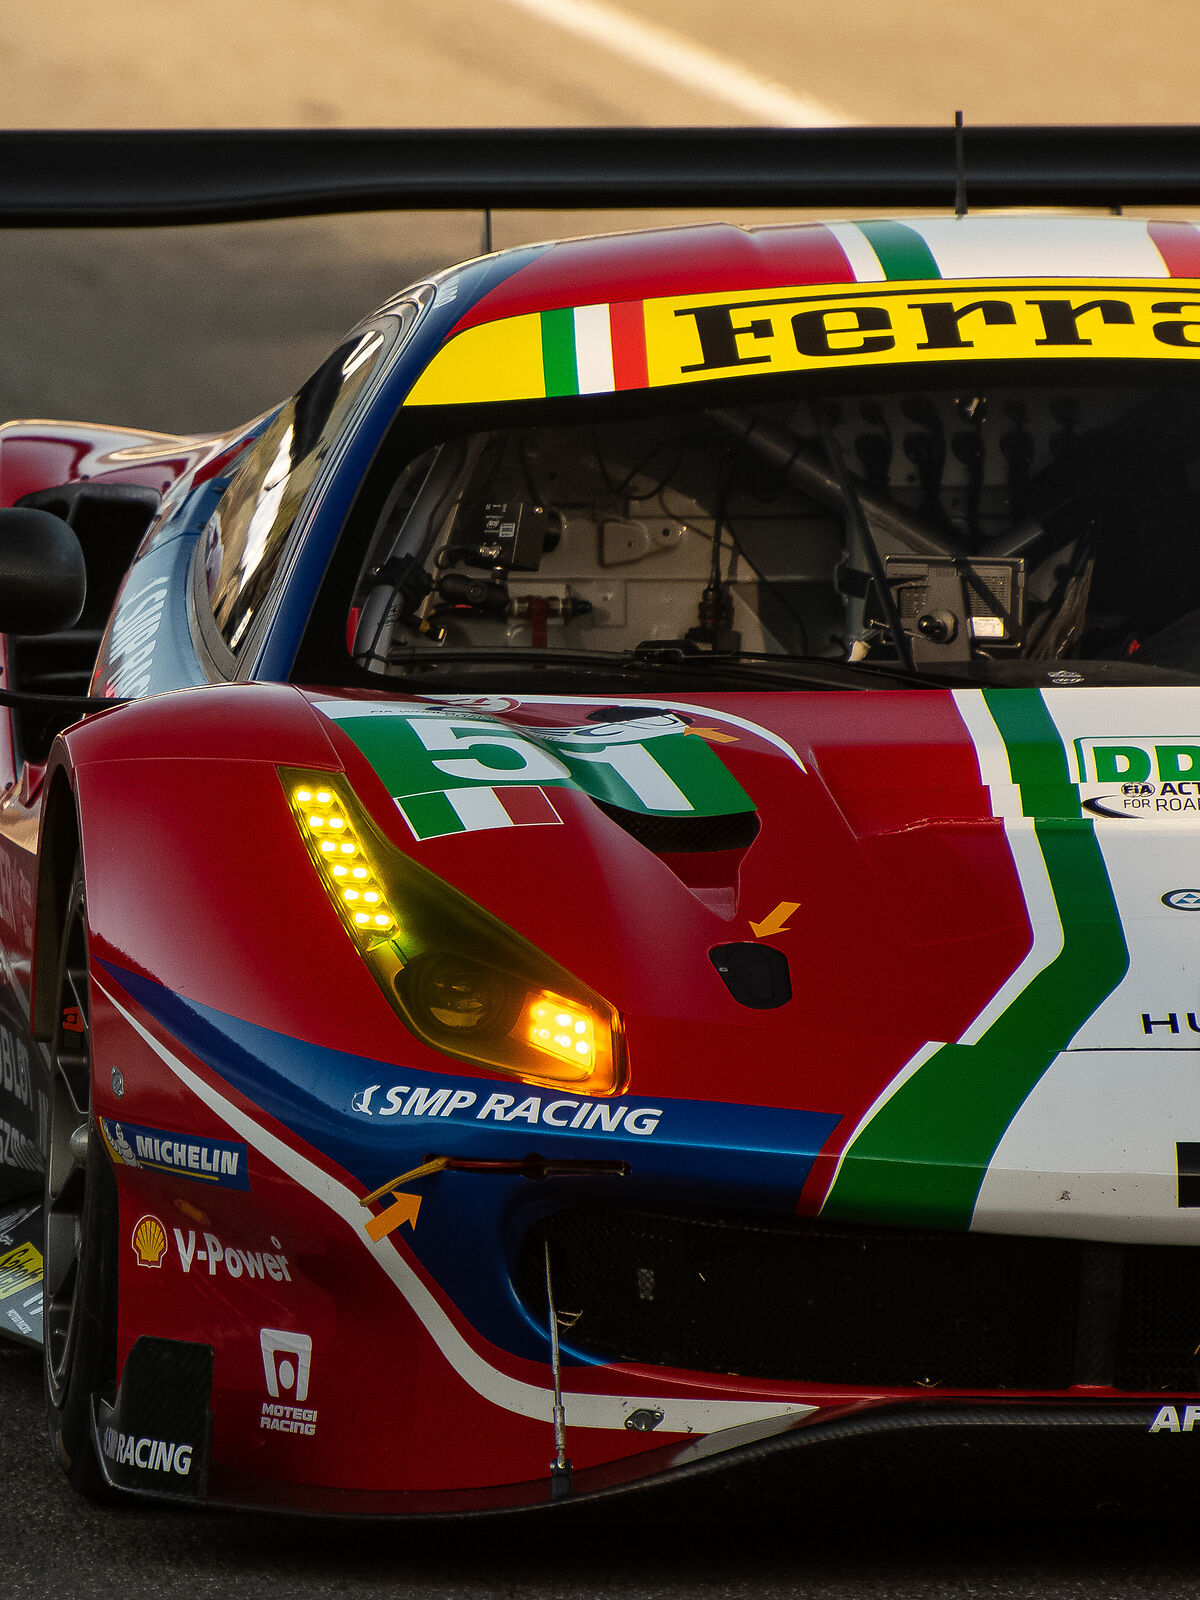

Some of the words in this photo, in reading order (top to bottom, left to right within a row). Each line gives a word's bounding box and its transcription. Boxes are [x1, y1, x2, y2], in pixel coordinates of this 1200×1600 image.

[405, 719, 695, 811] 51
[1124, 799, 1151, 809] FOR
[1156, 797, 1200, 811] ROA
[379, 1086, 477, 1117] SMP
[477, 1093, 663, 1135] RACING
[136, 1135, 239, 1176] MICHELIN
[173, 1228, 292, 1282] V-Power
[260, 1416, 316, 1436] RACING
[262, 1402, 318, 1422] MOTEGI
[1149, 1405, 1200, 1432] AF
[116, 1433, 193, 1475] RACING
